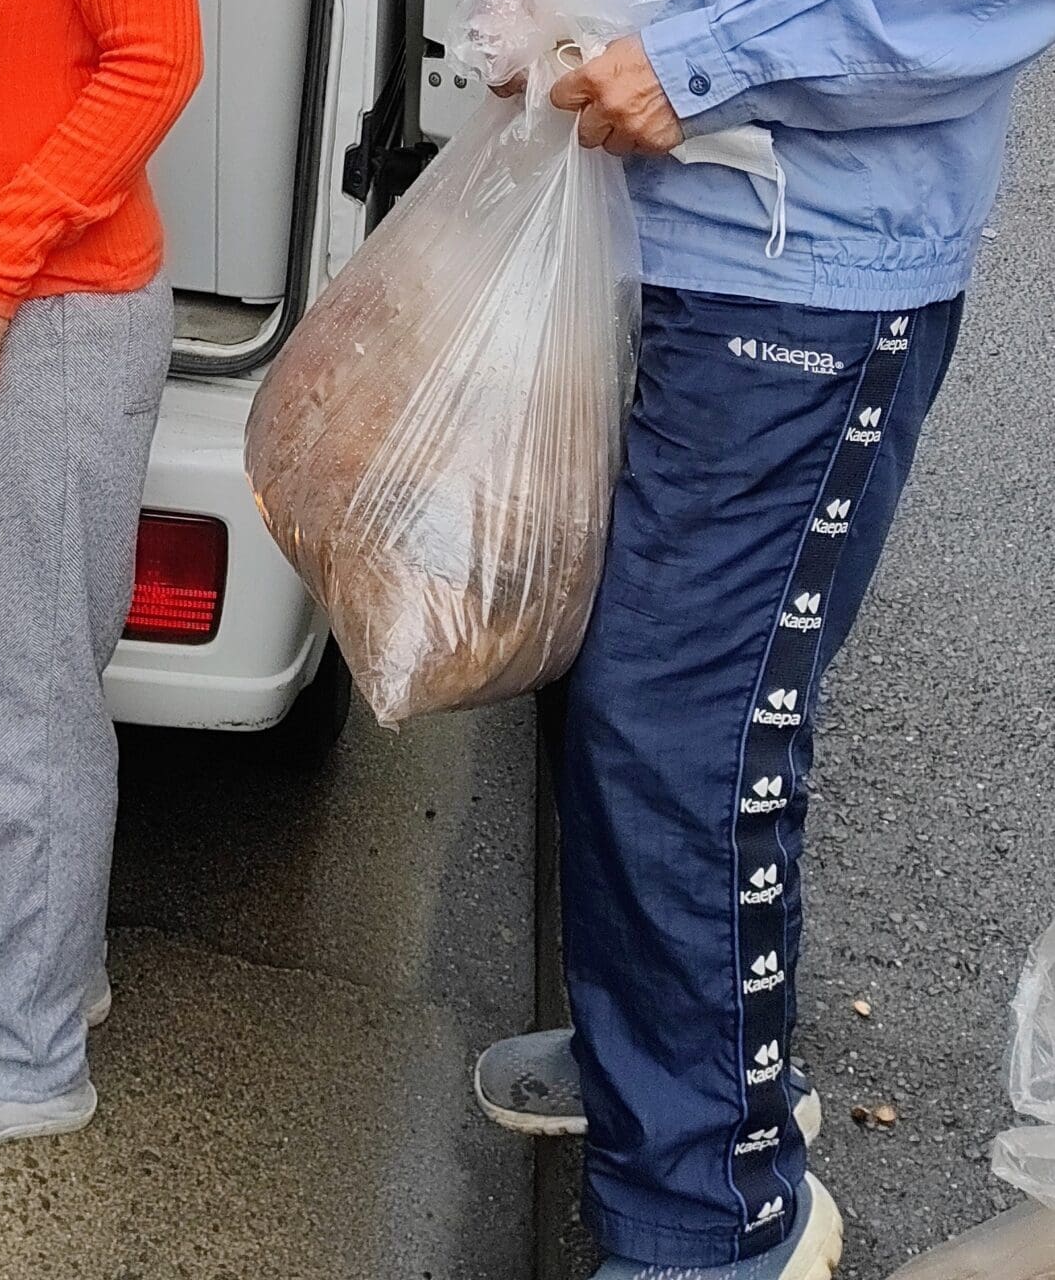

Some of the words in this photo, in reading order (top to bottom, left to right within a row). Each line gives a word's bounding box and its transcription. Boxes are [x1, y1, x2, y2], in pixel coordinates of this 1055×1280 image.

[876, 337, 908, 355] Kaepa
[845, 426, 882, 444] Kaepa
[810, 517, 849, 537] Kaepa
[779, 611, 822, 631] Kaepa
[752, 708, 801, 728] Kaepa
[740, 797, 787, 815] Kaepa
[739, 882, 784, 905] Kaepa
[742, 971, 785, 995] Kaepa
